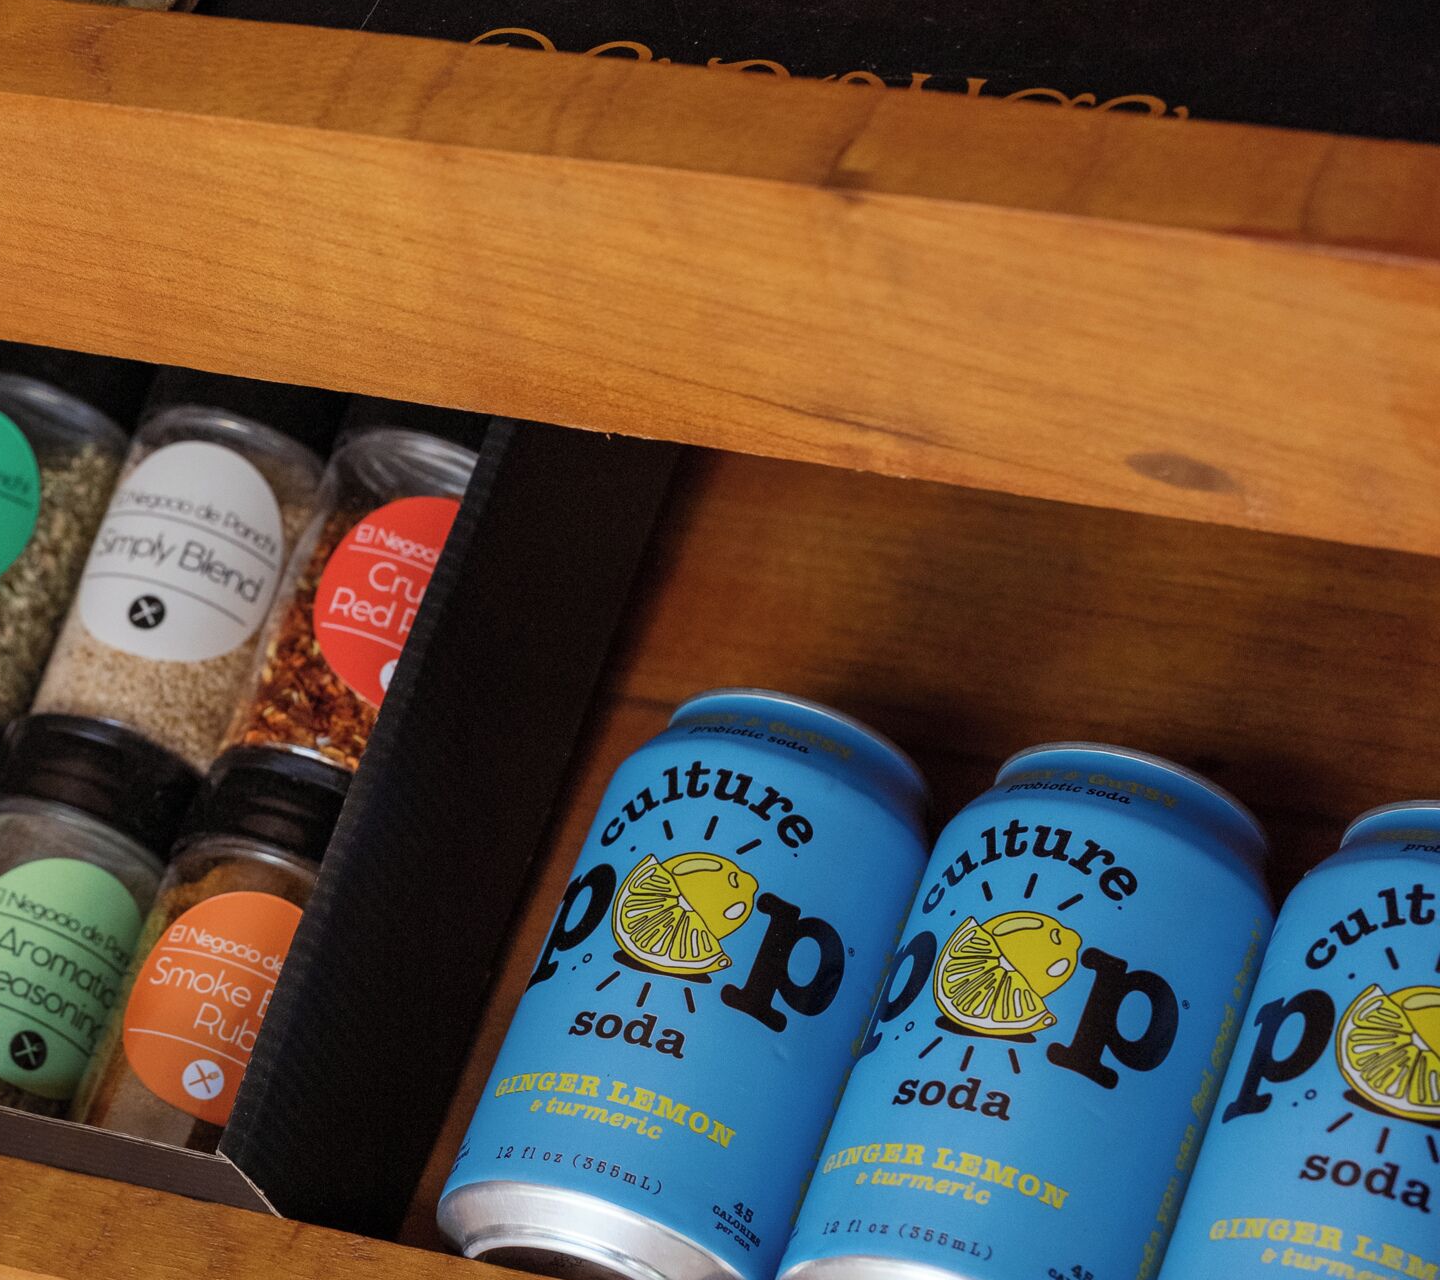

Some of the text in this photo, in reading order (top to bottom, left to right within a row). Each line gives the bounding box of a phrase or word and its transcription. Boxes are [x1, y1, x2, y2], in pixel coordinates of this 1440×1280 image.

[178, 538, 266, 604] Blend
[328, 586, 397, 629] Red
[688, 724, 810, 754] probiotic soda
[599, 760, 815, 849] culture
[1005, 780, 1132, 805] probiotic soda
[923, 818, 1138, 915] culture
[6, 891, 82, 933] Negocio
[80, 924, 104, 946] de
[1305, 884, 1436, 970] cult
[185, 927, 261, 963] Negocio
[149, 955, 252, 1009] Smoke
[192, 1001, 258, 1052] Rub
[567, 1009, 688, 1060] soda
[494, 1072, 737, 1149] GINGER LEMON
[545, 1095, 664, 1140] turmeric
[892, 1075, 1012, 1121] soda
[495, 1146, 514, 1160] 12
[542, 1151, 564, 1164] oz
[572, 1153, 664, 1196] (355mL)
[822, 1142, 1069, 1210] GINGER LEMON
[870, 1167, 992, 1205] turmeric
[1298, 1153, 1432, 1213] soda
[712, 1204, 762, 1248] CALORIES
[714, 1221, 752, 1252] per can
[733, 1201, 755, 1224] 45
[1209, 1217, 1344, 1252] GINGER
[822, 1220, 840, 1236] 12
[868, 1223, 889, 1235] oz
[898, 1222, 994, 1262] (355mL)
